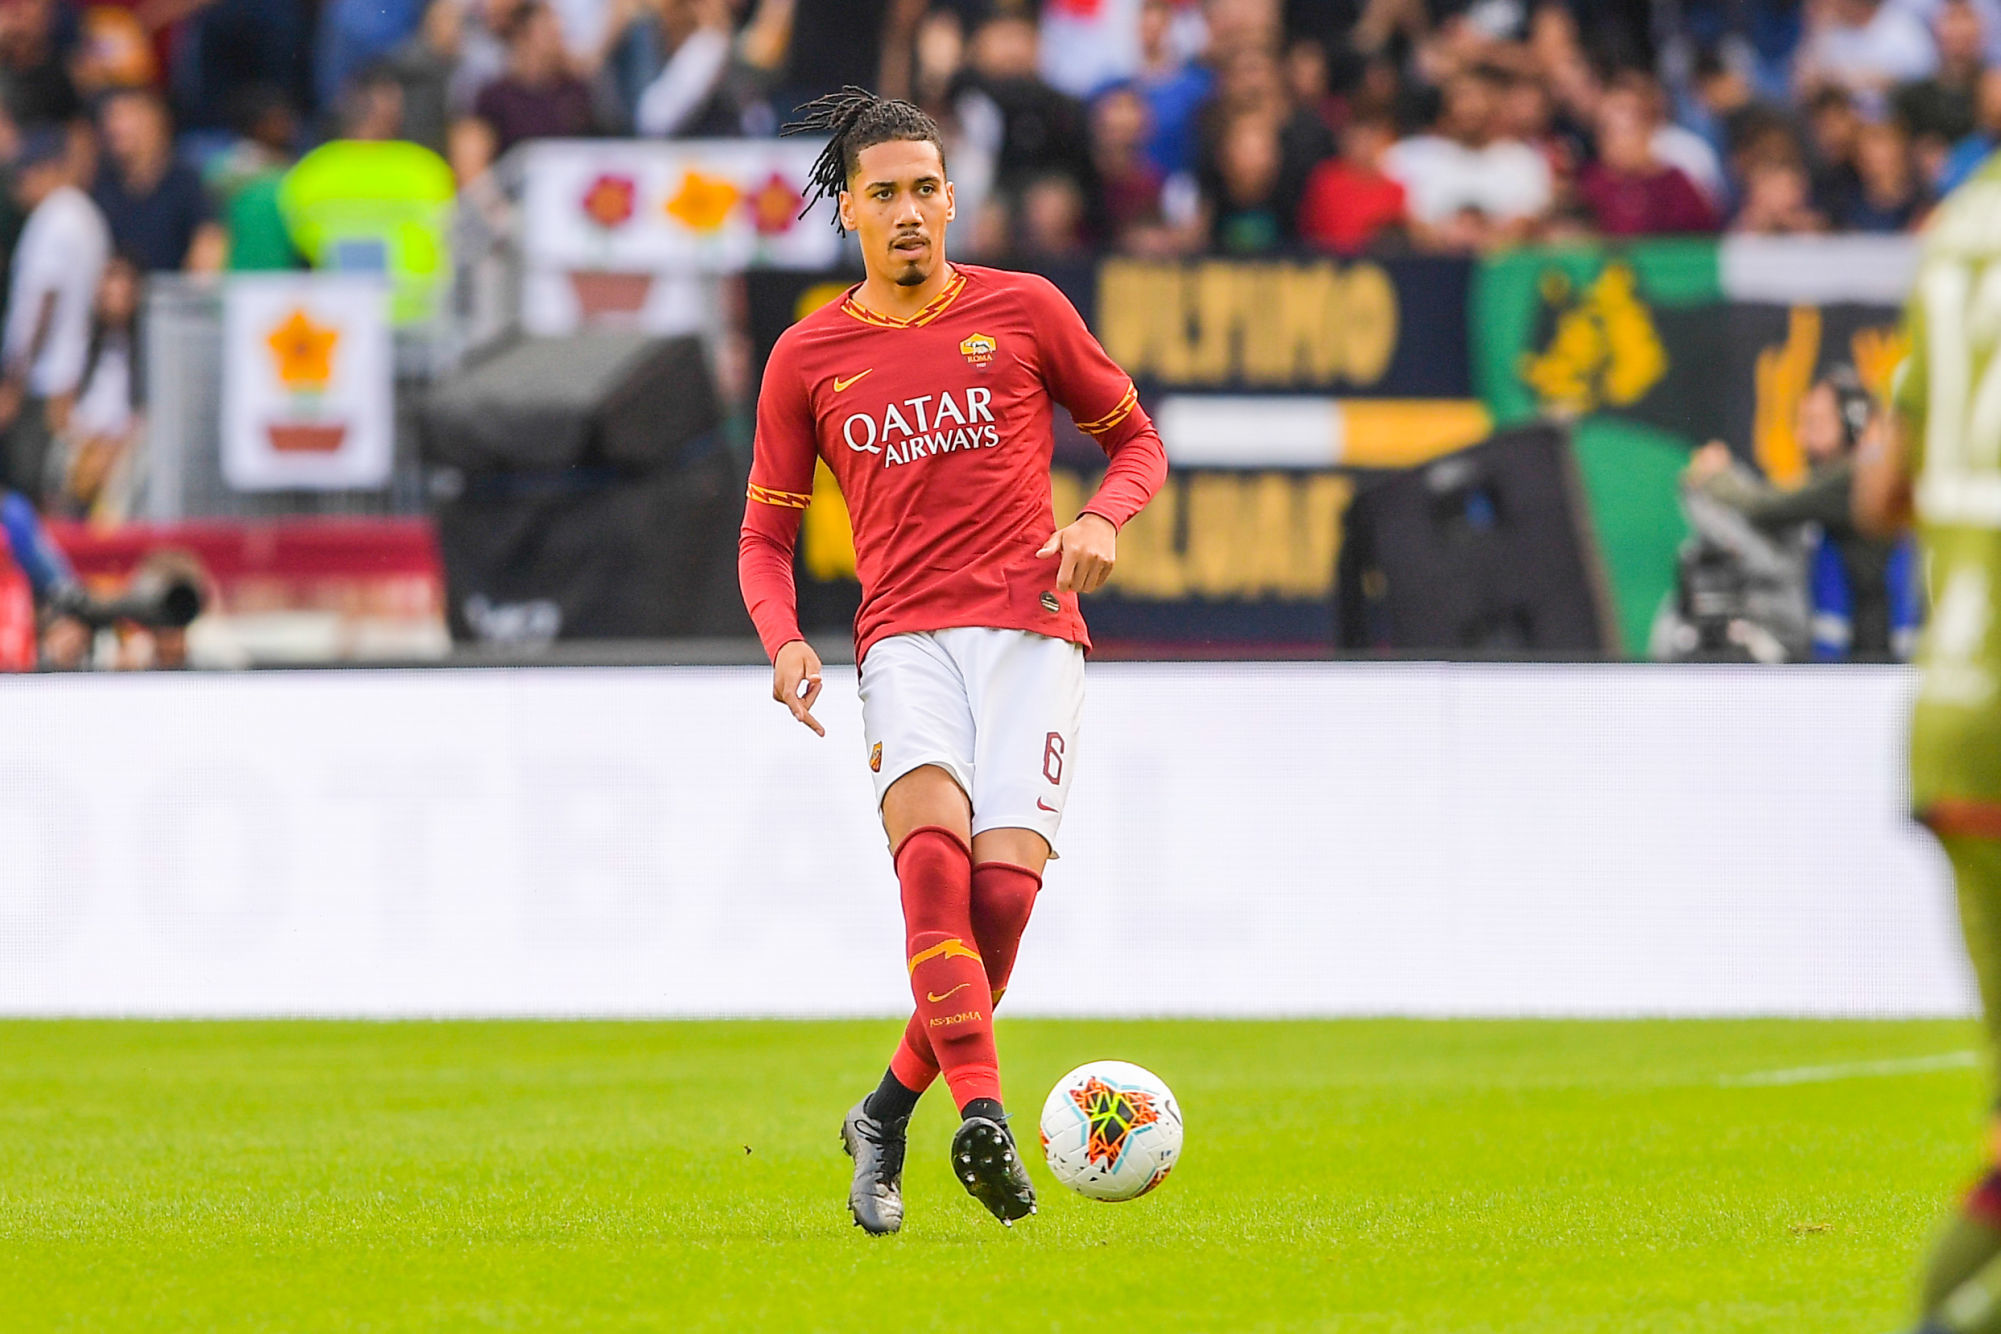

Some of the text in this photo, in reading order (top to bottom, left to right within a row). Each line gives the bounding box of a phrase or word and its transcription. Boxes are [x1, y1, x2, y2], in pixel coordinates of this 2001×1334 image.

[967, 353, 993, 363] ROMA
[843, 387, 995, 455] QATAR
[884, 425, 999, 469] AIRWAYS
[1043, 731, 1065, 786] 6
